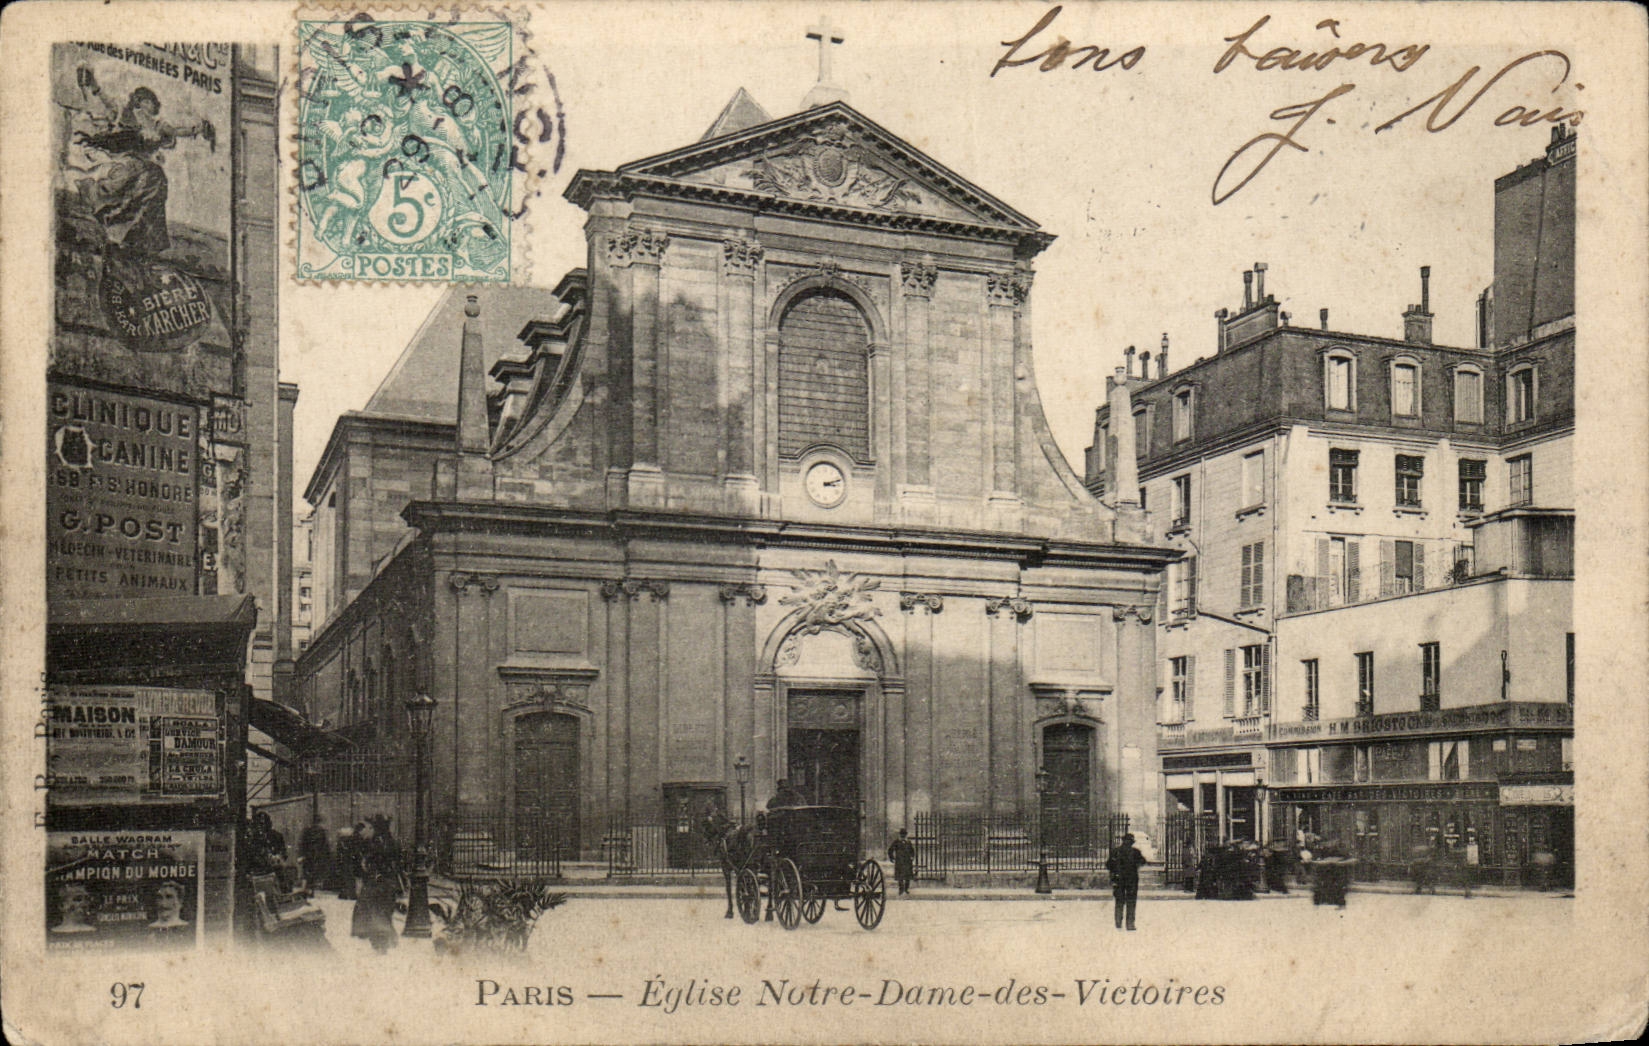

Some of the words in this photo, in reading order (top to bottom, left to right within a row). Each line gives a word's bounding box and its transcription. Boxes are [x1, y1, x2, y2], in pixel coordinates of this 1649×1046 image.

[107, 43, 124, 60] des
[183, 64, 223, 95] PARIS
[356, 256, 450, 278] POSTES
[142, 301, 211, 337] KARCHER
[52, 392, 192, 439] CLINIQUE
[99, 438, 191, 475] CANINE
[94, 512, 185, 545] POST
[56, 566, 108, 584] PETITS
[119, 573, 188, 593] ANIMAUX
[53, 705, 136, 724] MAISON
[71, 836, 114, 845] SALLE
[116, 835, 172, 845] WAGRAM
[87, 849, 160, 860] MATCH
[125, 866, 144, 879] DU
[148, 864, 197, 878] MONDE
